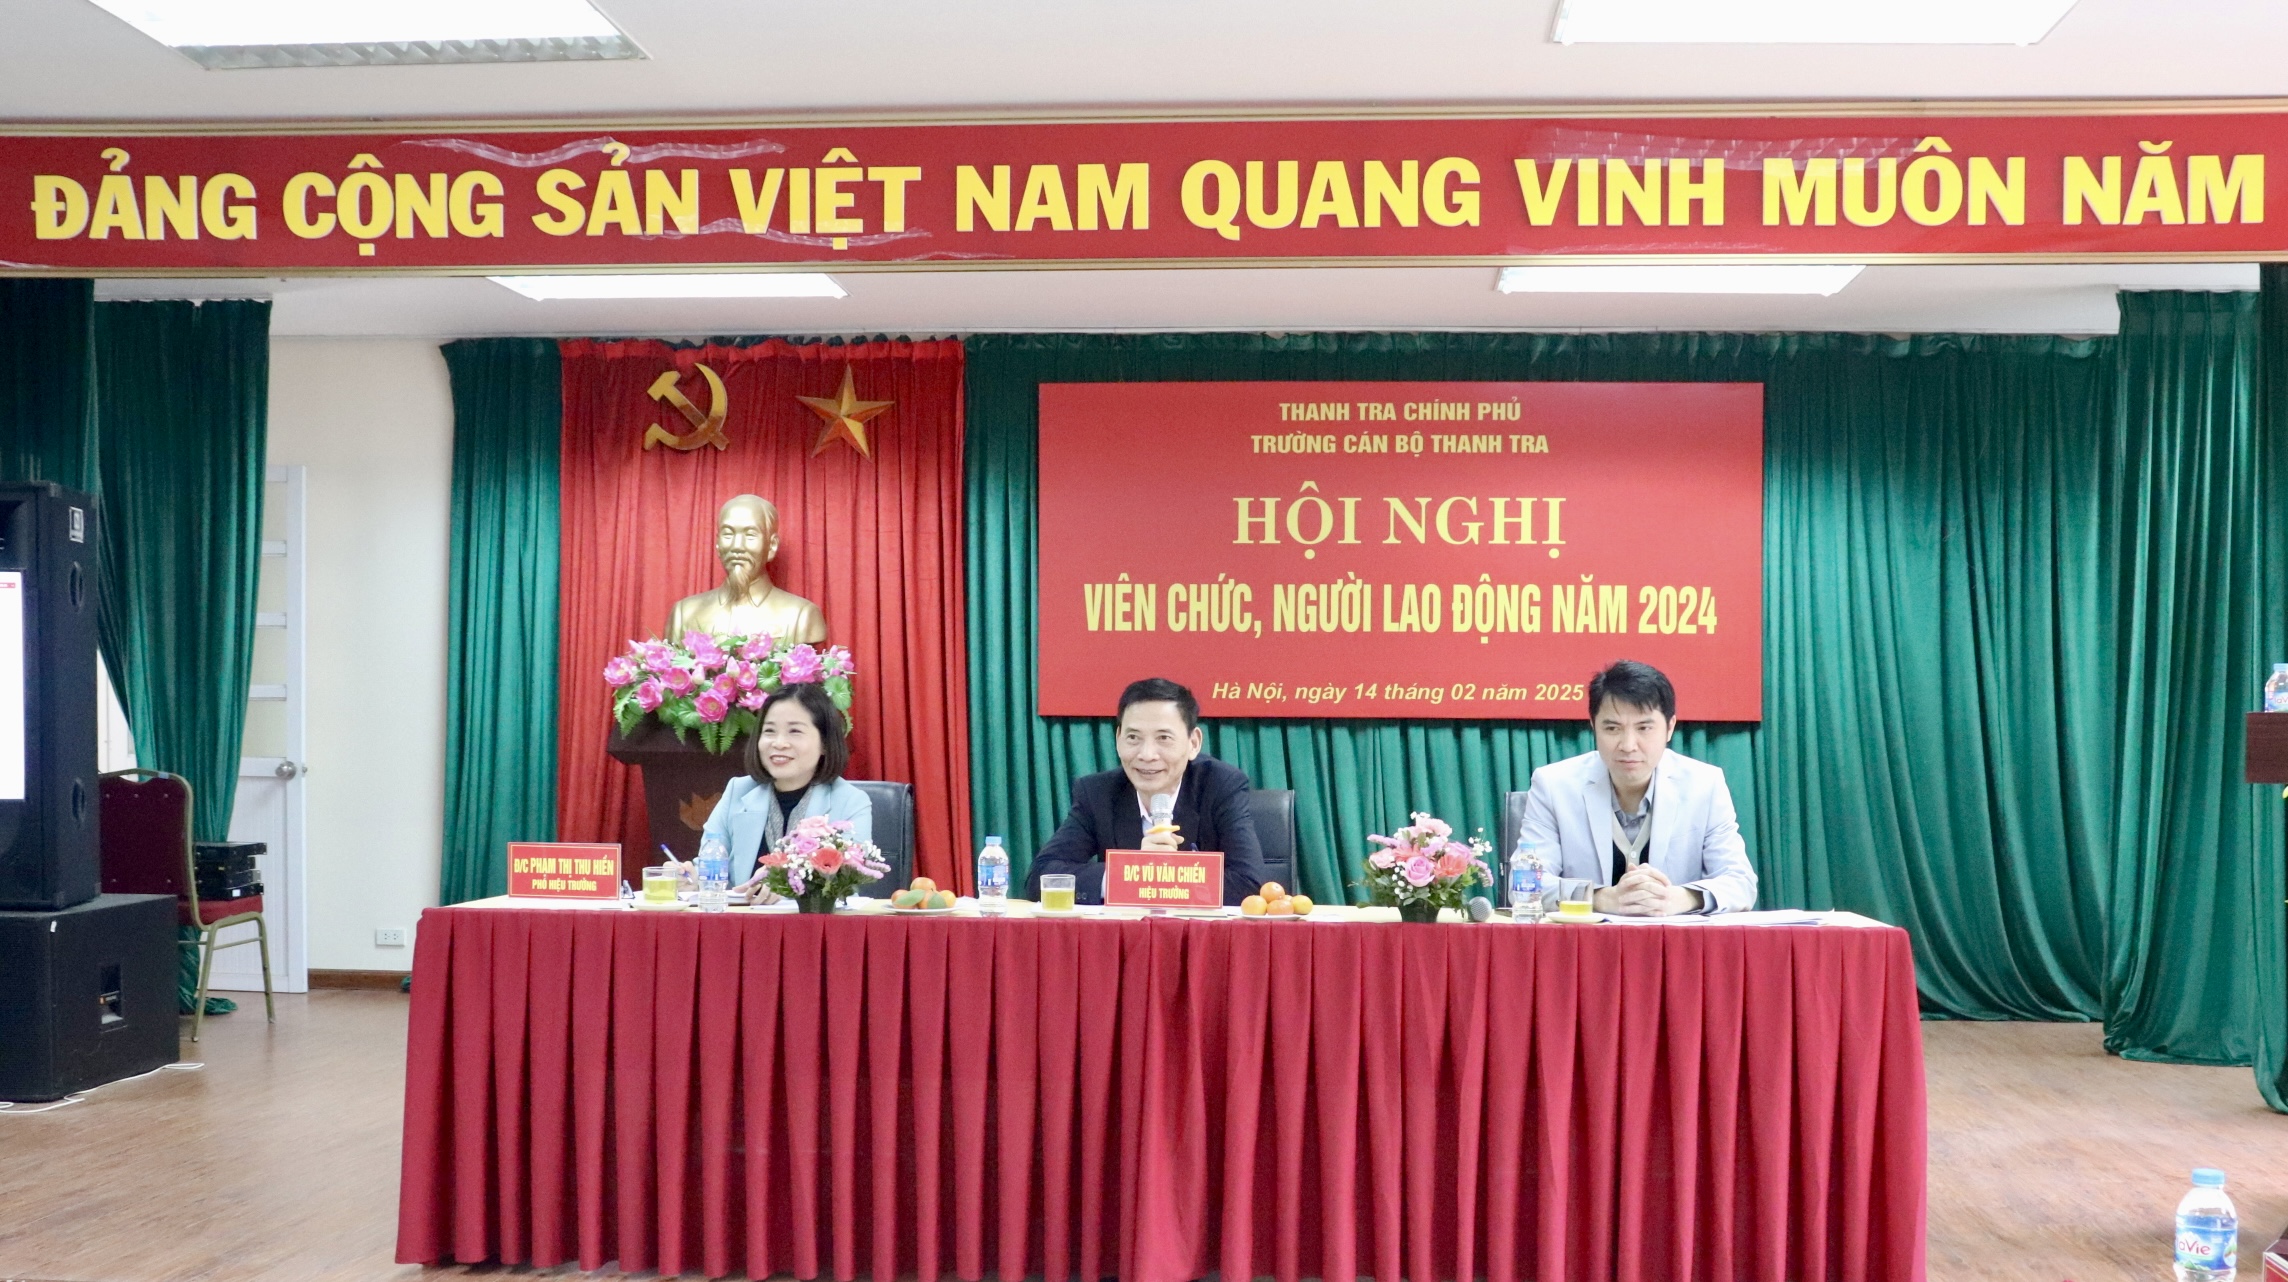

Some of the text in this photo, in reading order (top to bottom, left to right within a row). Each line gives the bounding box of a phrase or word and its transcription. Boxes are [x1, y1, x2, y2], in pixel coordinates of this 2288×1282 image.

[31, 136, 2264, 256] ĐẢNG CỘNG SẢN VIỆT NAM QUANG VINH MUÔN NĂM
[1280, 396, 1521, 421] THANH TRA CHÍNH PHỦ
[1251, 430, 1549, 457] TRƯỜNG CÁN BỘ THANH TRA
[1233, 481, 1567, 560] HỘI NGHỊ
[1084, 571, 1717, 645] VIÊN CHỨC, NGƯỜI LAO ĐỘNG NĂM 2024
[1212, 682, 1584, 704] Hà Nội, ngày 14 tháng 02 năm 2025
[514, 858, 529, 873] Đ/C
[530, 857, 556, 878] PHẠM
[558, 858, 573, 878] THỊ
[574, 859, 591, 875] THU
[1124, 861, 1206, 884] Đ/C VŨ VĂN CHIẾN
[532, 878, 547, 890] PHÓ
[549, 877, 566, 893] HIỆU
[1139, 885, 1190, 901] HIỆU TRƯỞNG
